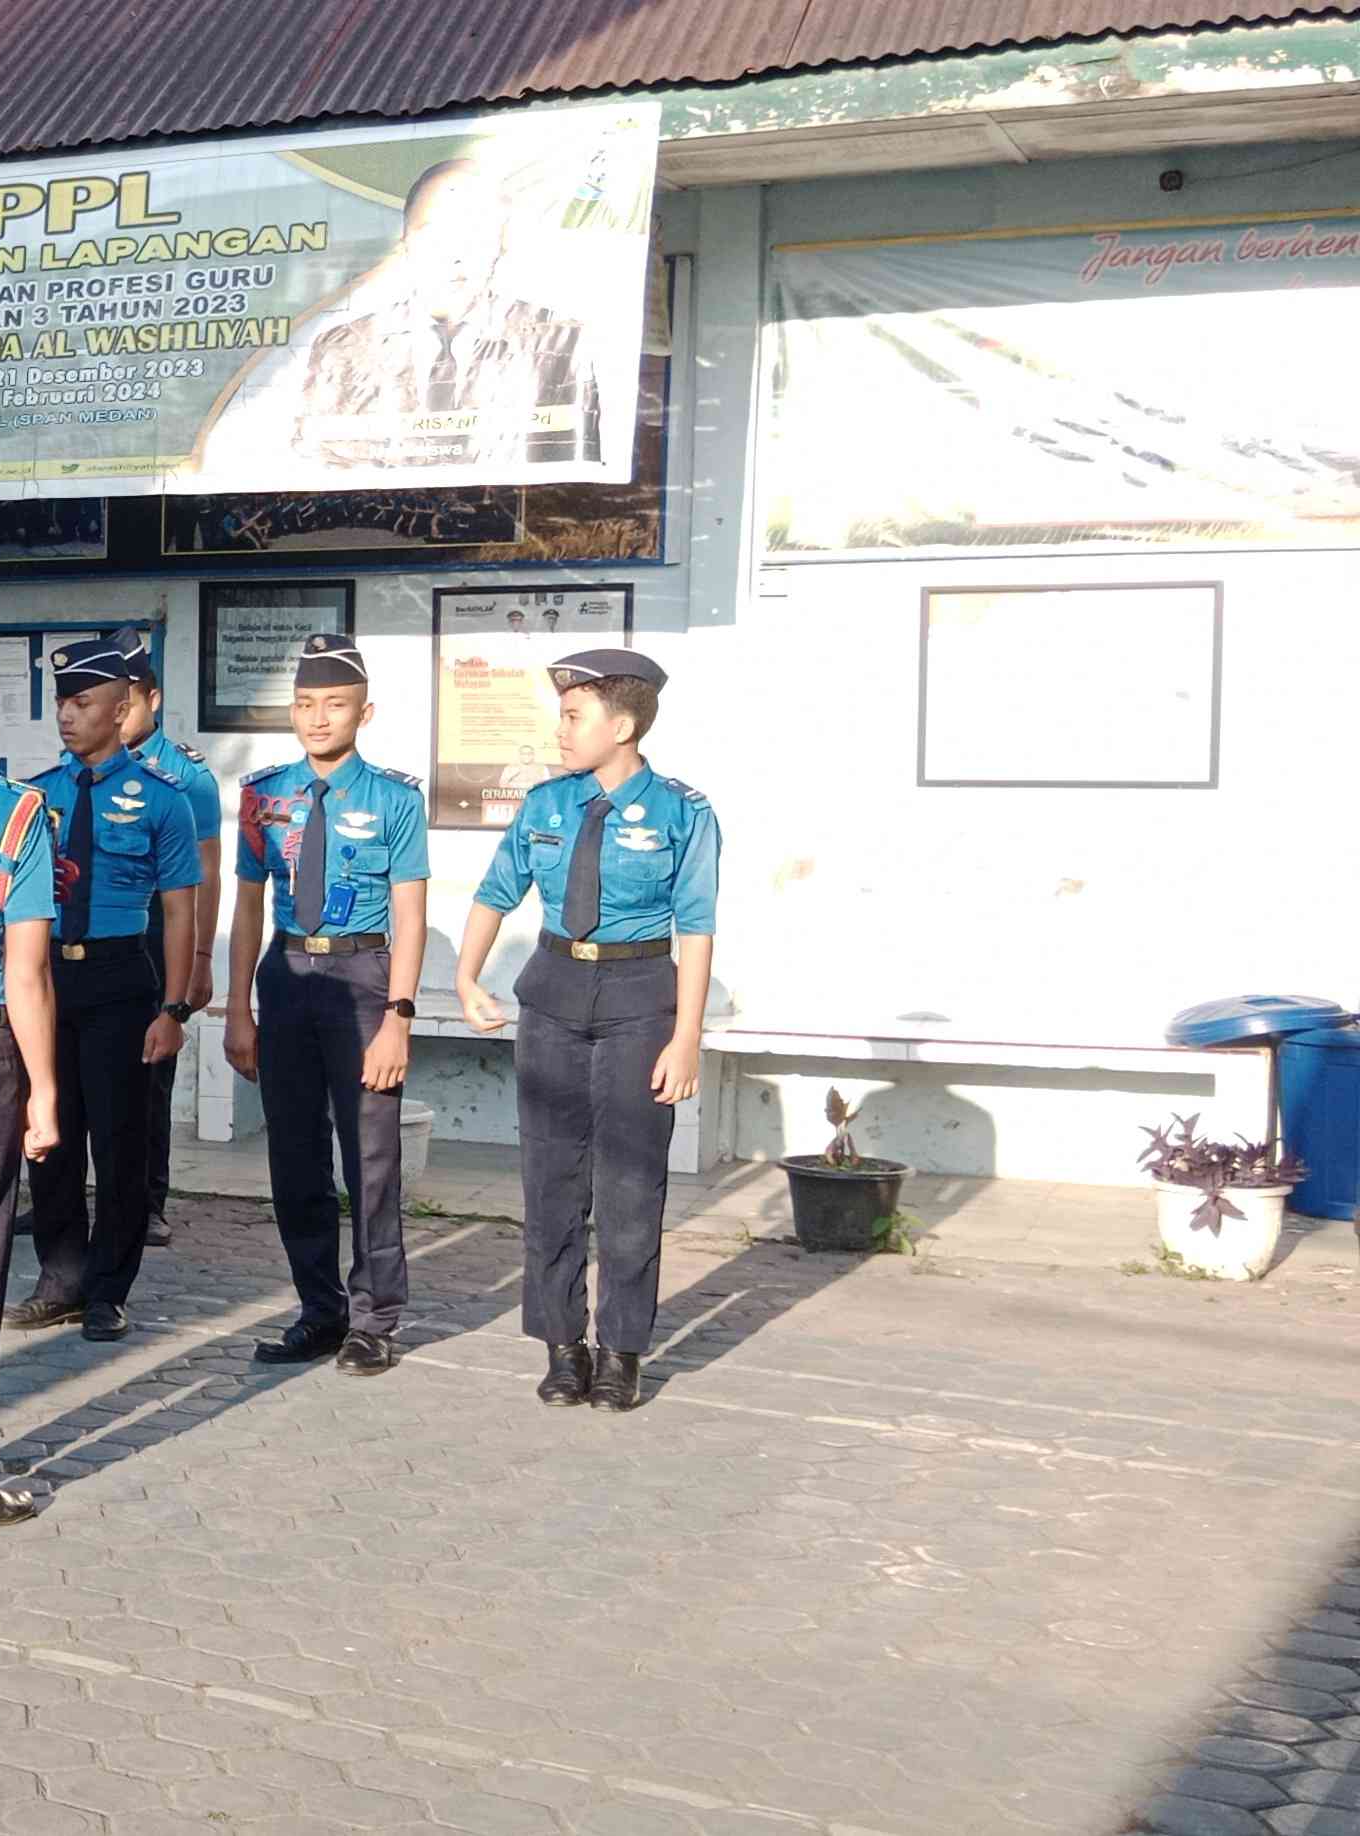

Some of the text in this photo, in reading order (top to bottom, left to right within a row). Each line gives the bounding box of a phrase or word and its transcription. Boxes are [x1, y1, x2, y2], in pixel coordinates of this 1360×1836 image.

[40, 221, 327, 270] LAPANGAN
[1081, 231, 1224, 287] Jangan
[47, 273, 173, 300] PROFESI
[185, 266, 274, 288] GURU
[33, 308, 48, 325] 3
[61, 299, 162, 324] TAHUN
[174, 293, 245, 317] 2023
[32, 330, 75, 360] AL
[85, 317, 290, 355] WASHLIYAH
[27, 361, 136, 386] Desember
[145, 359, 204, 378] 2023
[2, 386, 95, 408] Februari
[103, 382, 161, 401] 2024
[80, 408, 159, 424] MEDAN)
